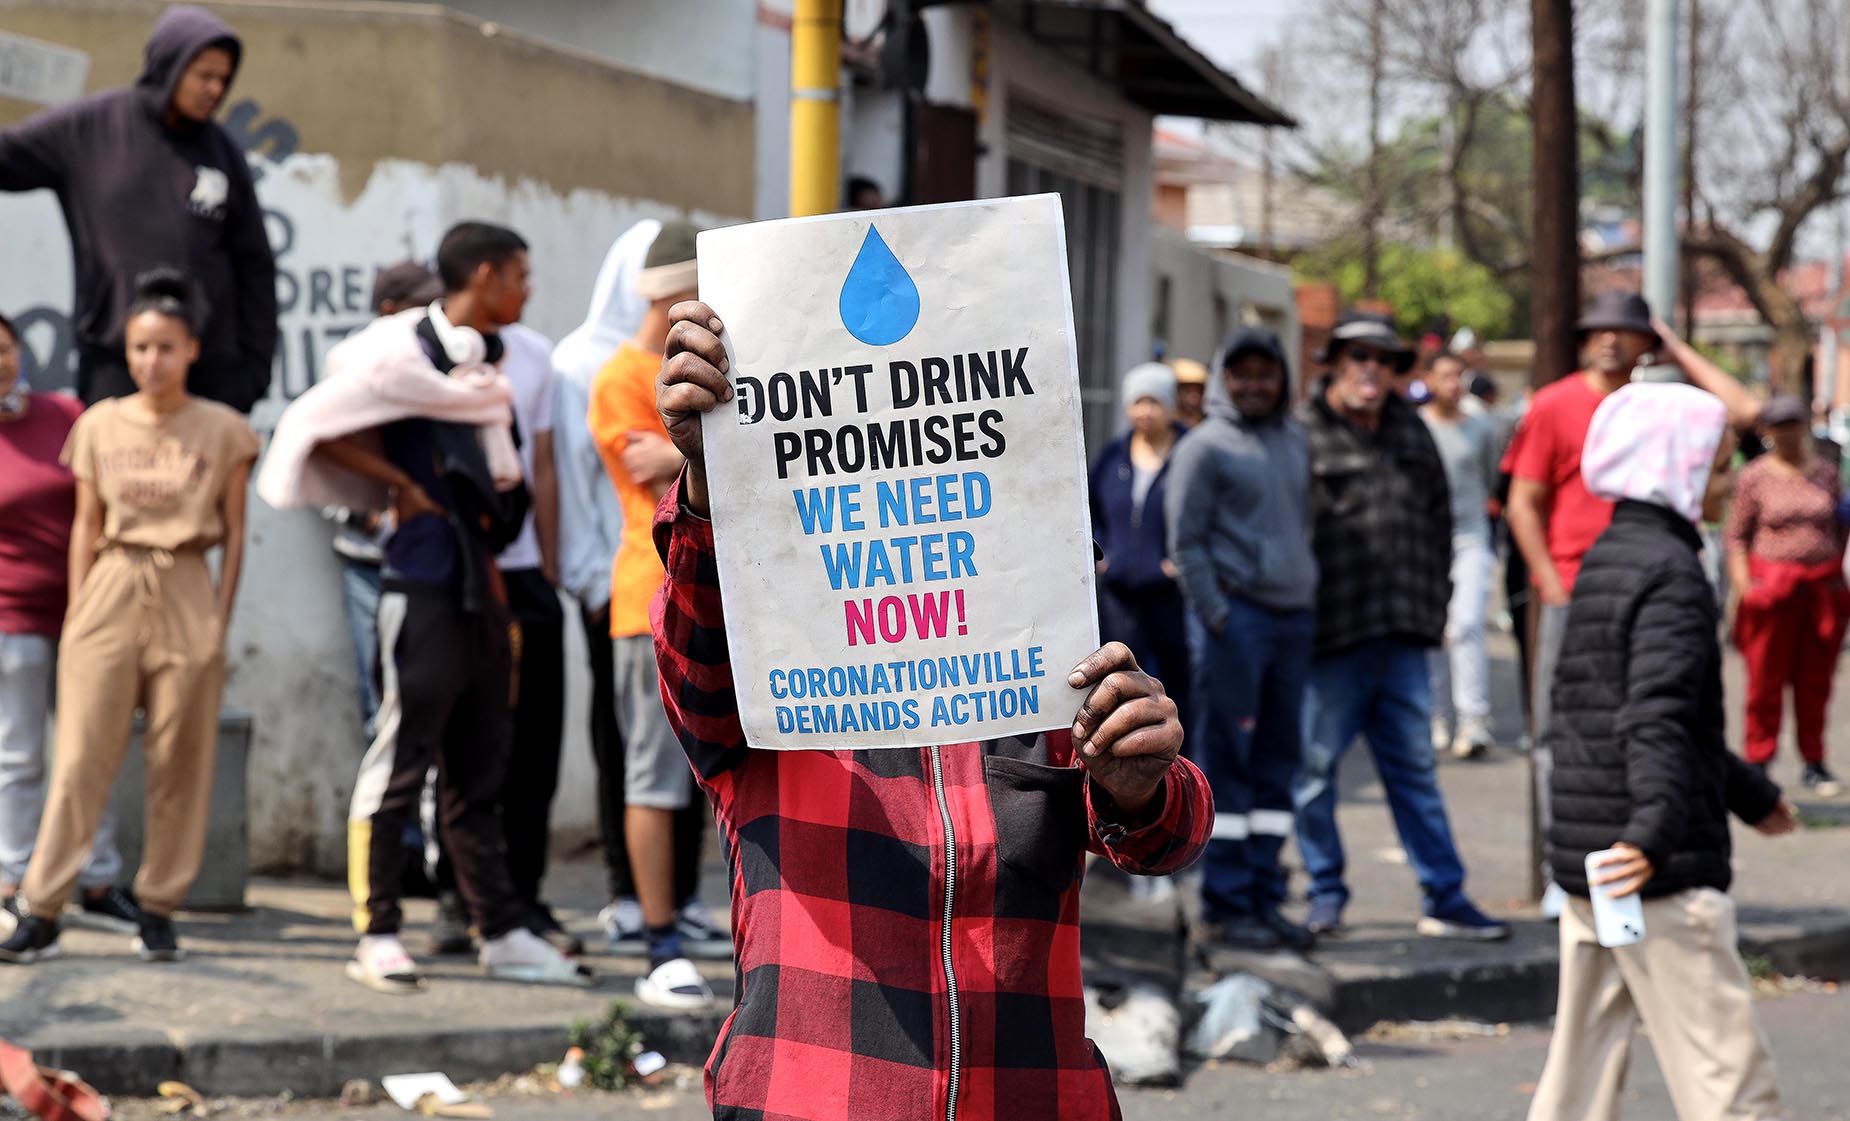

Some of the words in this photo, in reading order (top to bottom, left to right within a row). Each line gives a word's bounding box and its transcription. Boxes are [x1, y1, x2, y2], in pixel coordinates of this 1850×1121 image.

[735, 363, 874, 425] DON'T
[888, 347, 1035, 410] DRINK
[773, 409, 1006, 480] PROMISES
[792, 484, 866, 535] WE
[876, 471, 992, 529] NEED
[819, 530, 978, 591] WATER
[844, 589, 968, 647] NOW!
[769, 646, 1045, 700] CORONATIONVILLE
[775, 699, 921, 734] DEMANDS
[931, 685, 1039, 727] ACTION
